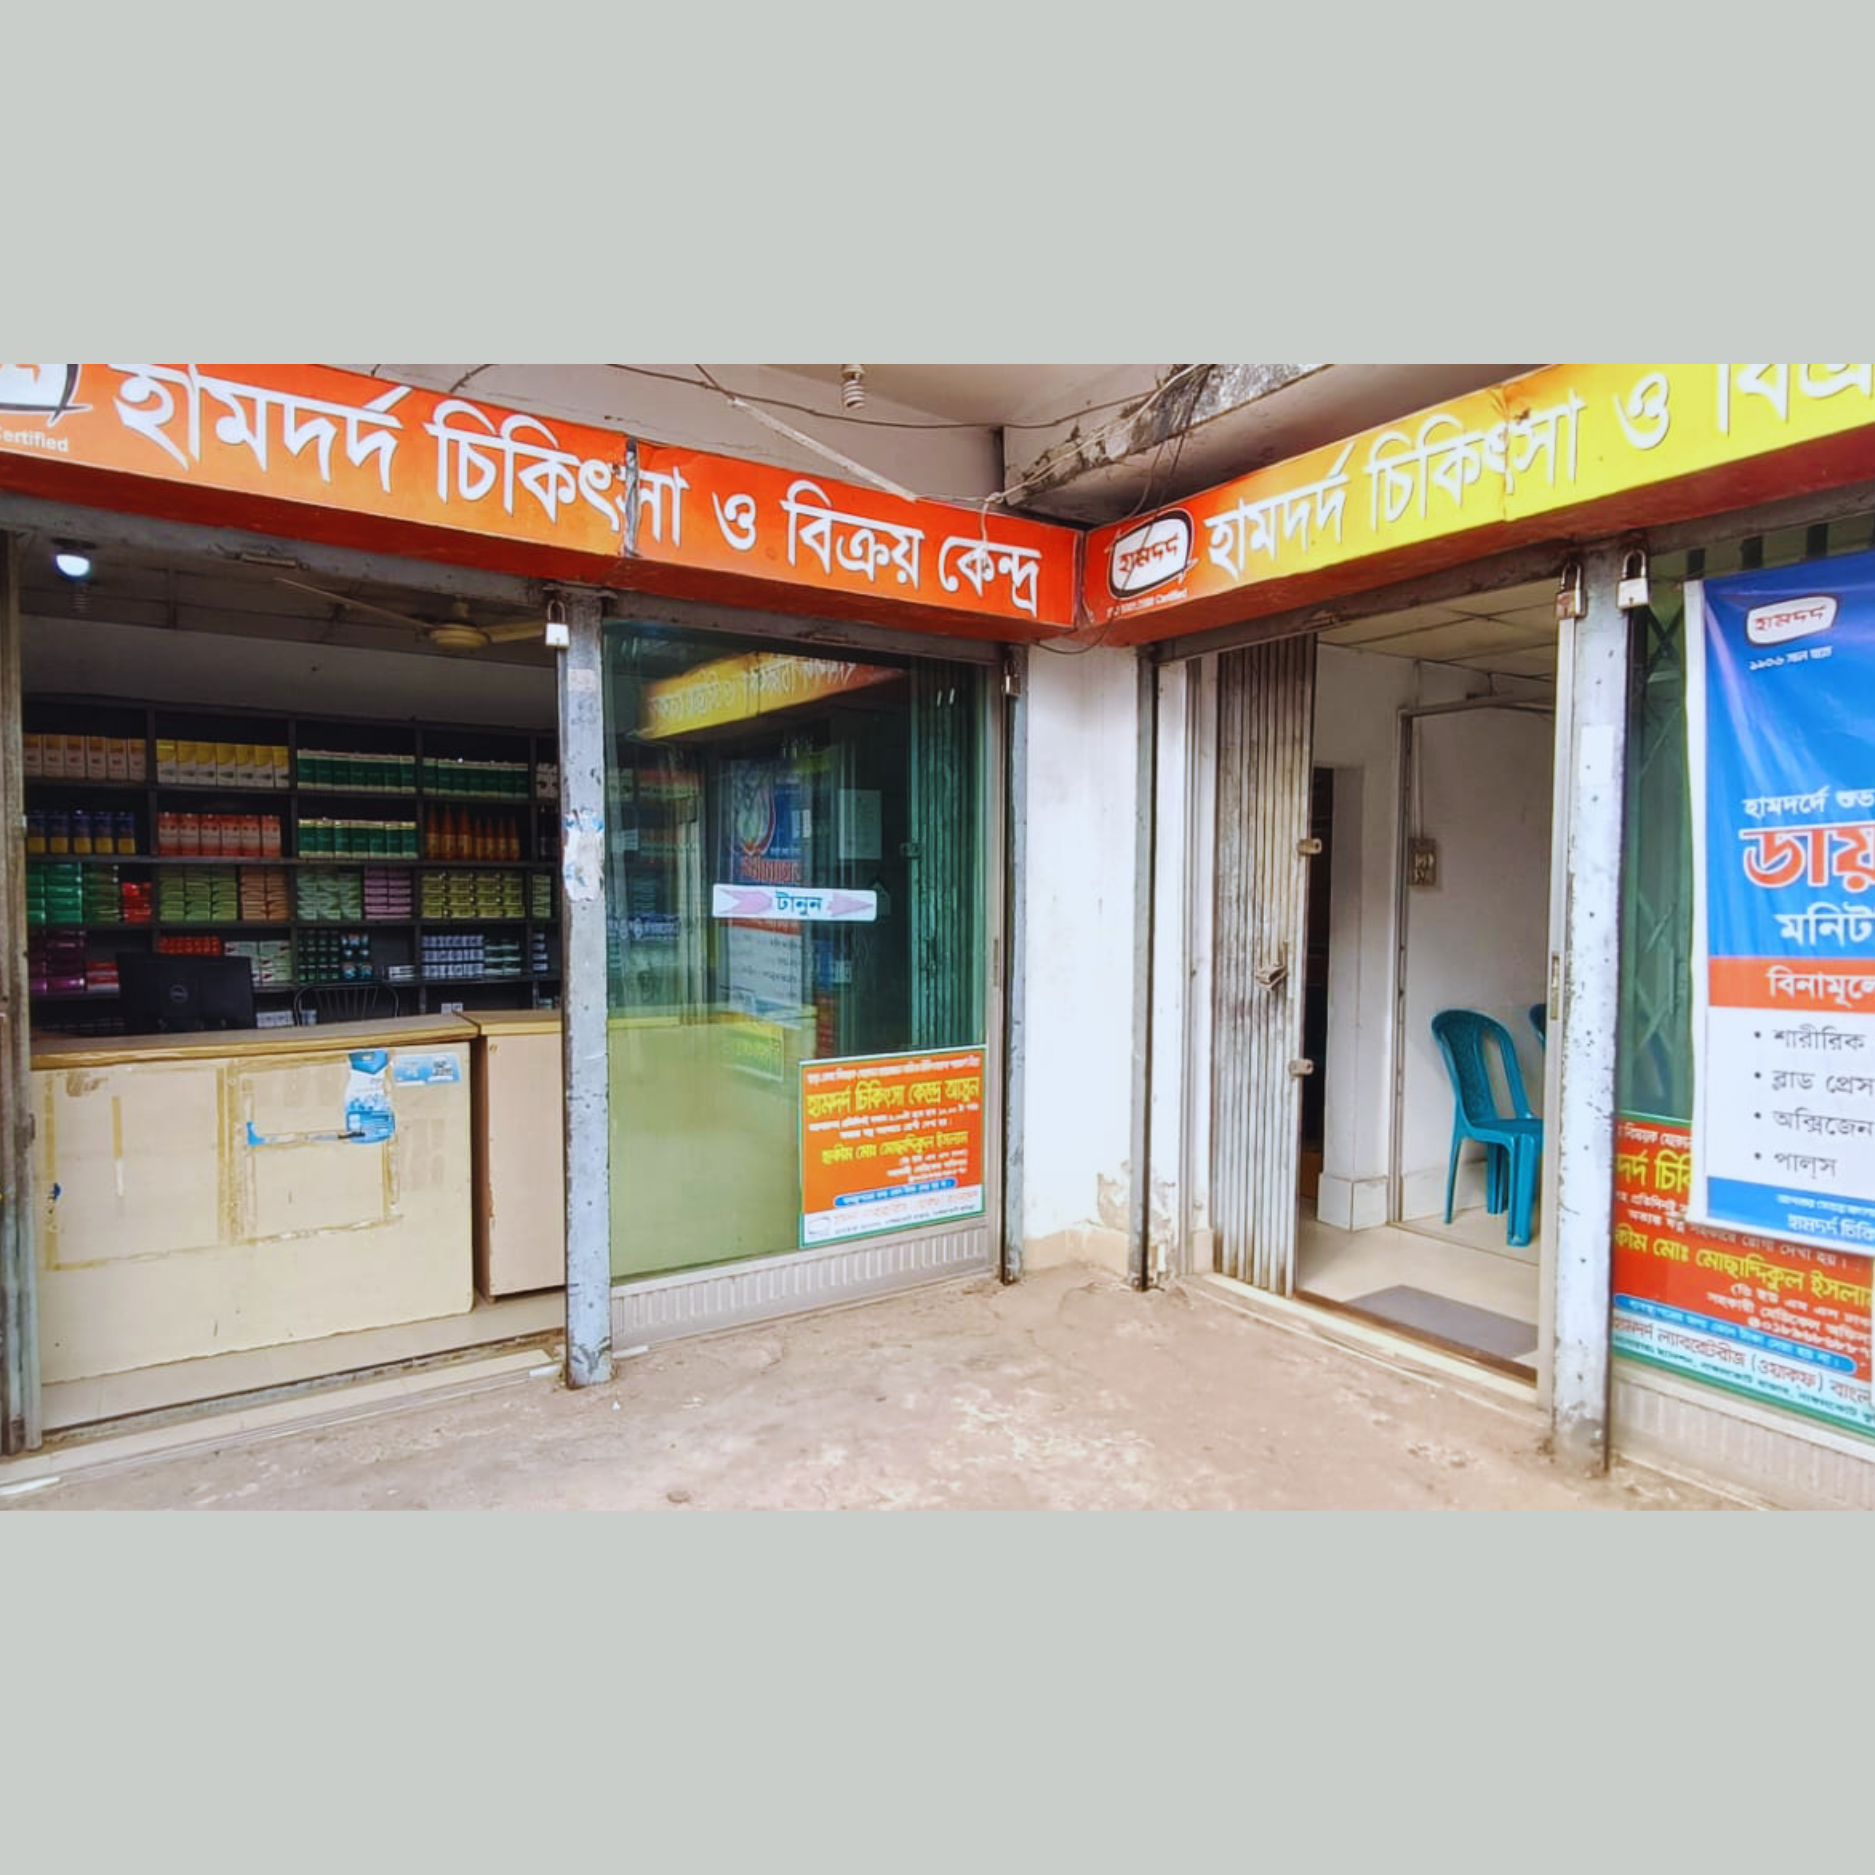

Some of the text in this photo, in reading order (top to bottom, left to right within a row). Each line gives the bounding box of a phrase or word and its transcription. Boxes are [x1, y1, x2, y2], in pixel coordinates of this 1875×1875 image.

[0, 428, 68, 453] ertified
[108, 364, 413, 493] হামদর্দ
[712, 491, 757, 551] ও
[780, 480, 925, 590] বিক্রয়
[938, 536, 1042, 618] কেন্দ্র
[1204, 441, 1352, 582] হামদর্দ
[1363, 413, 1587, 533] চিকিৎসা
[1613, 371, 1671, 451] ও
[1743, 785, 1831, 819] হামদর্দে
[1773, 1023, 1867, 1051] শারীরিক
